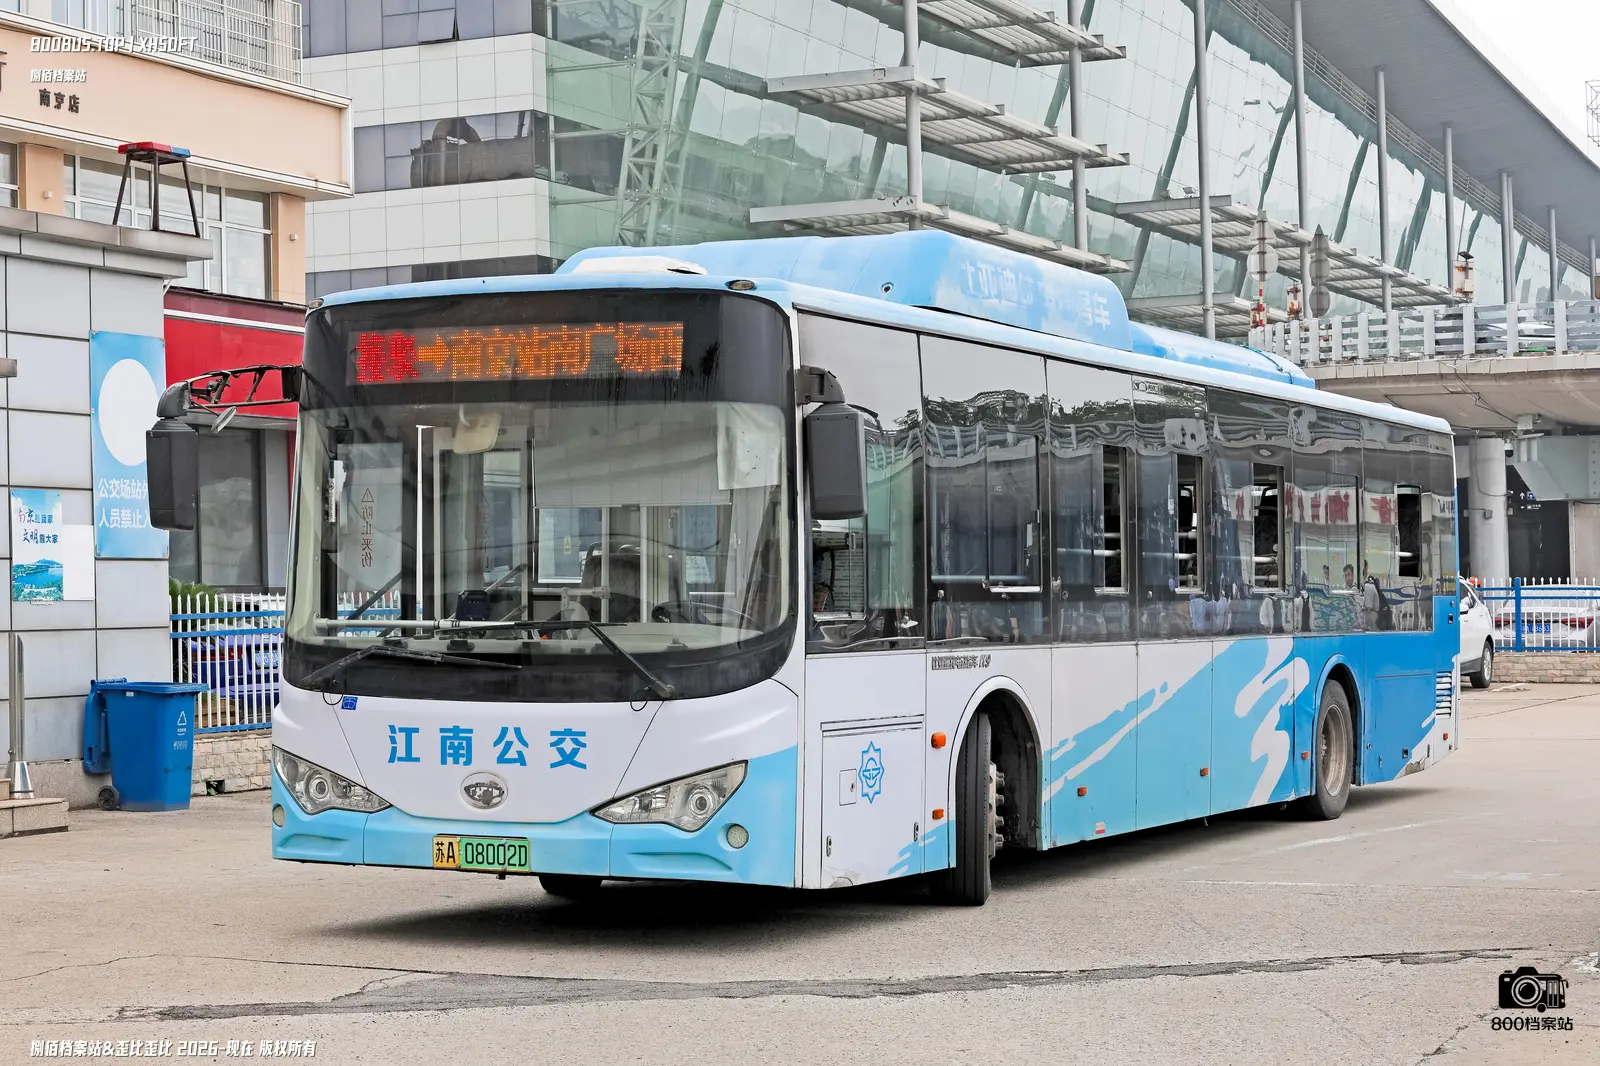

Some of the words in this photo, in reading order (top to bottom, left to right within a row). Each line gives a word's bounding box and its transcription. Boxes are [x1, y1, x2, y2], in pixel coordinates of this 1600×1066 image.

[39, 88, 80, 114] 南京店
[452, 321, 684, 380] 南京站南广场西
[388, 724, 588, 769] 江南公交
[434, 840, 457, 865] 苏A
[464, 842, 528, 867] 08002D
